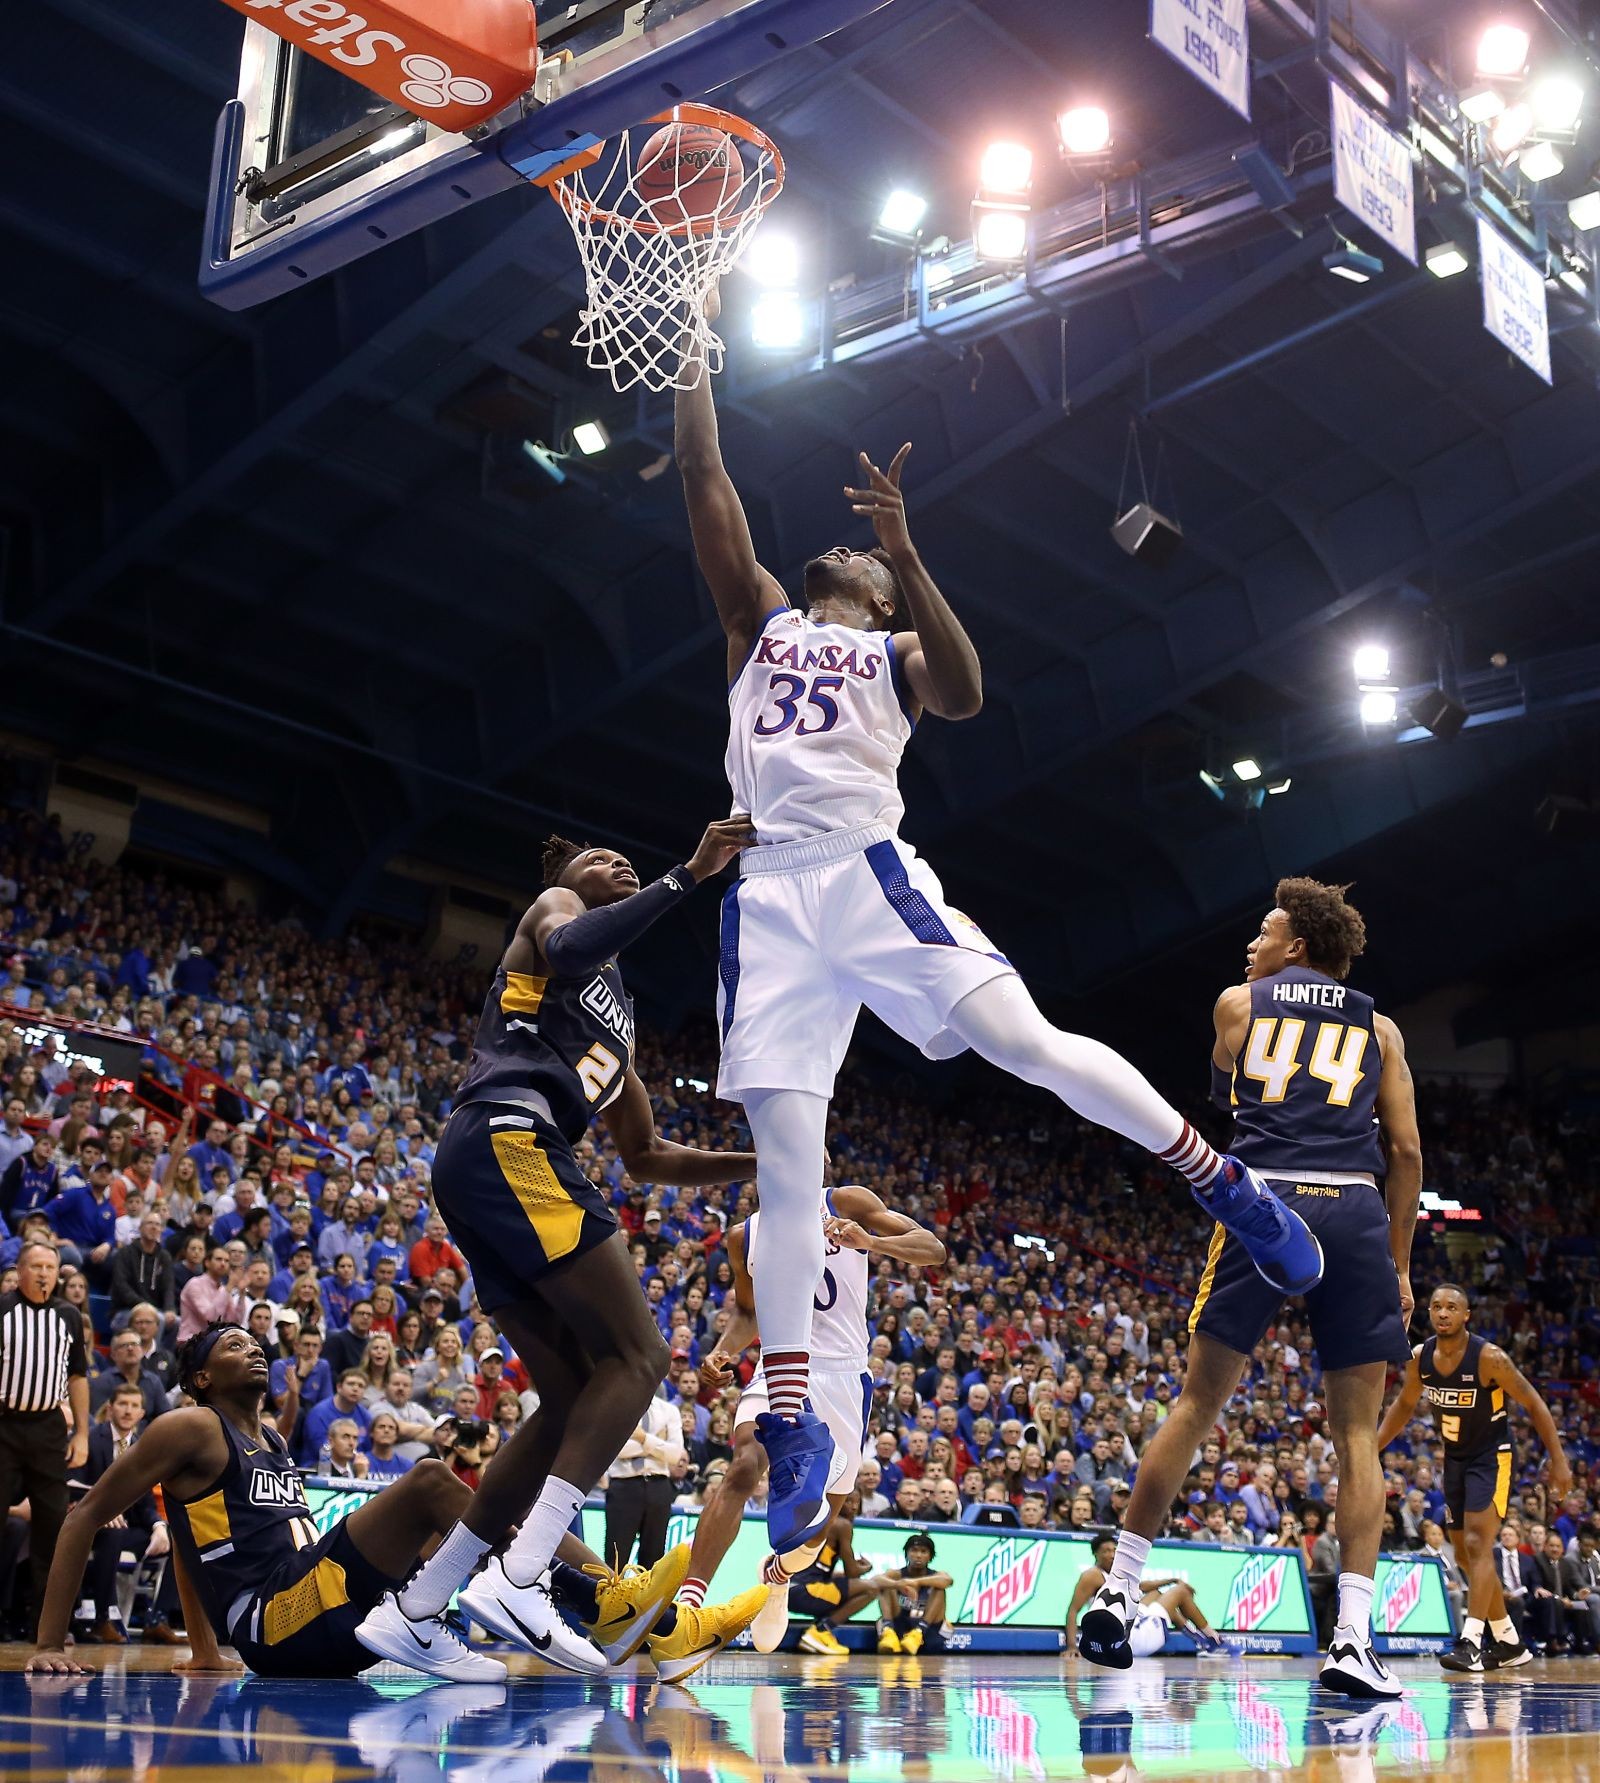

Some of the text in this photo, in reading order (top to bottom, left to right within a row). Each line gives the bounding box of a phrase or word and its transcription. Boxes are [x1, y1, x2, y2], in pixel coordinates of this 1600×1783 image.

[1184, 25, 1219, 79] 1991
[660, 148, 731, 172] Wilson
[754, 636, 882, 680] KANSAS
[753, 673, 845, 736] 35
[581, 976, 633, 1046] UNC
[1272, 983, 1346, 1009] HUNTER
[575, 1041, 621, 1103] 2
[1244, 1017, 1369, 1107] 44
[1295, 1184, 1340, 1198] SPARTANS
[1441, 1413, 1460, 1442] 2
[251, 1469, 309, 1507] UN
[1247, 1636, 1283, 1653] Mortgage
